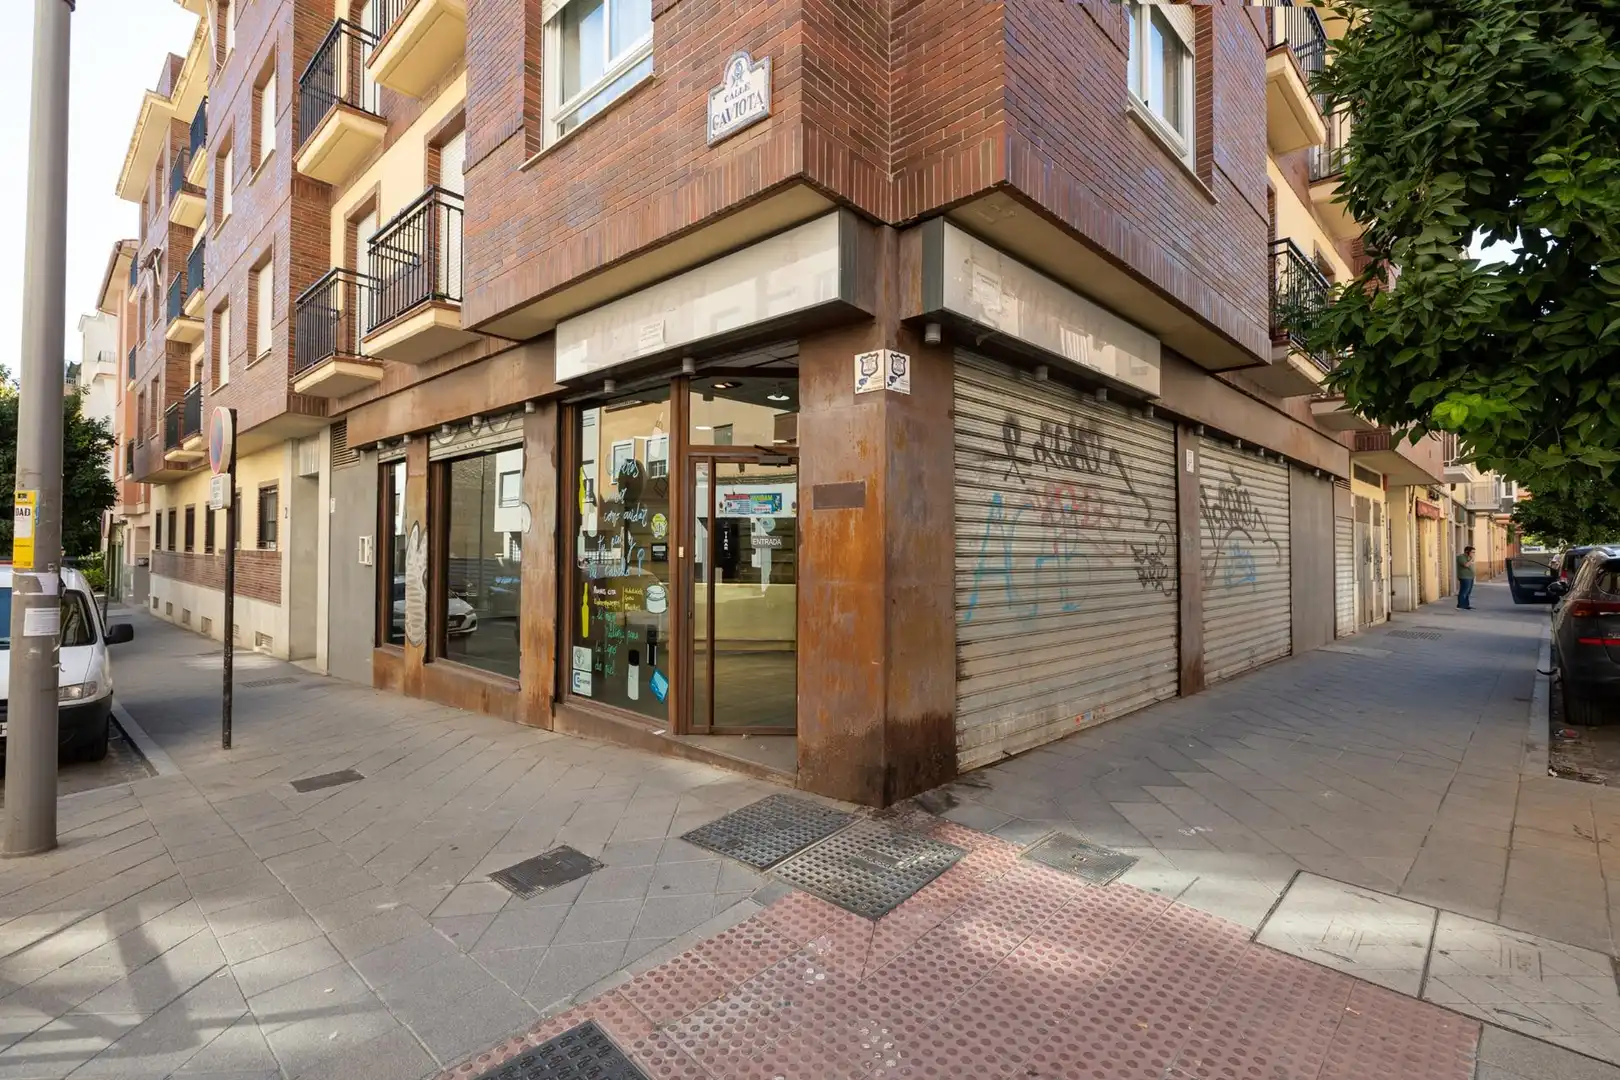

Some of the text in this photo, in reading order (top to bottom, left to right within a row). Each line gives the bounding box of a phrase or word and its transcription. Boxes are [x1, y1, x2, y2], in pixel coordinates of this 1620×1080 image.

[724, 82, 750, 103] CALLE
[712, 90, 764, 130] GAVIOTA
[752, 538, 782, 546] ENTRADA
